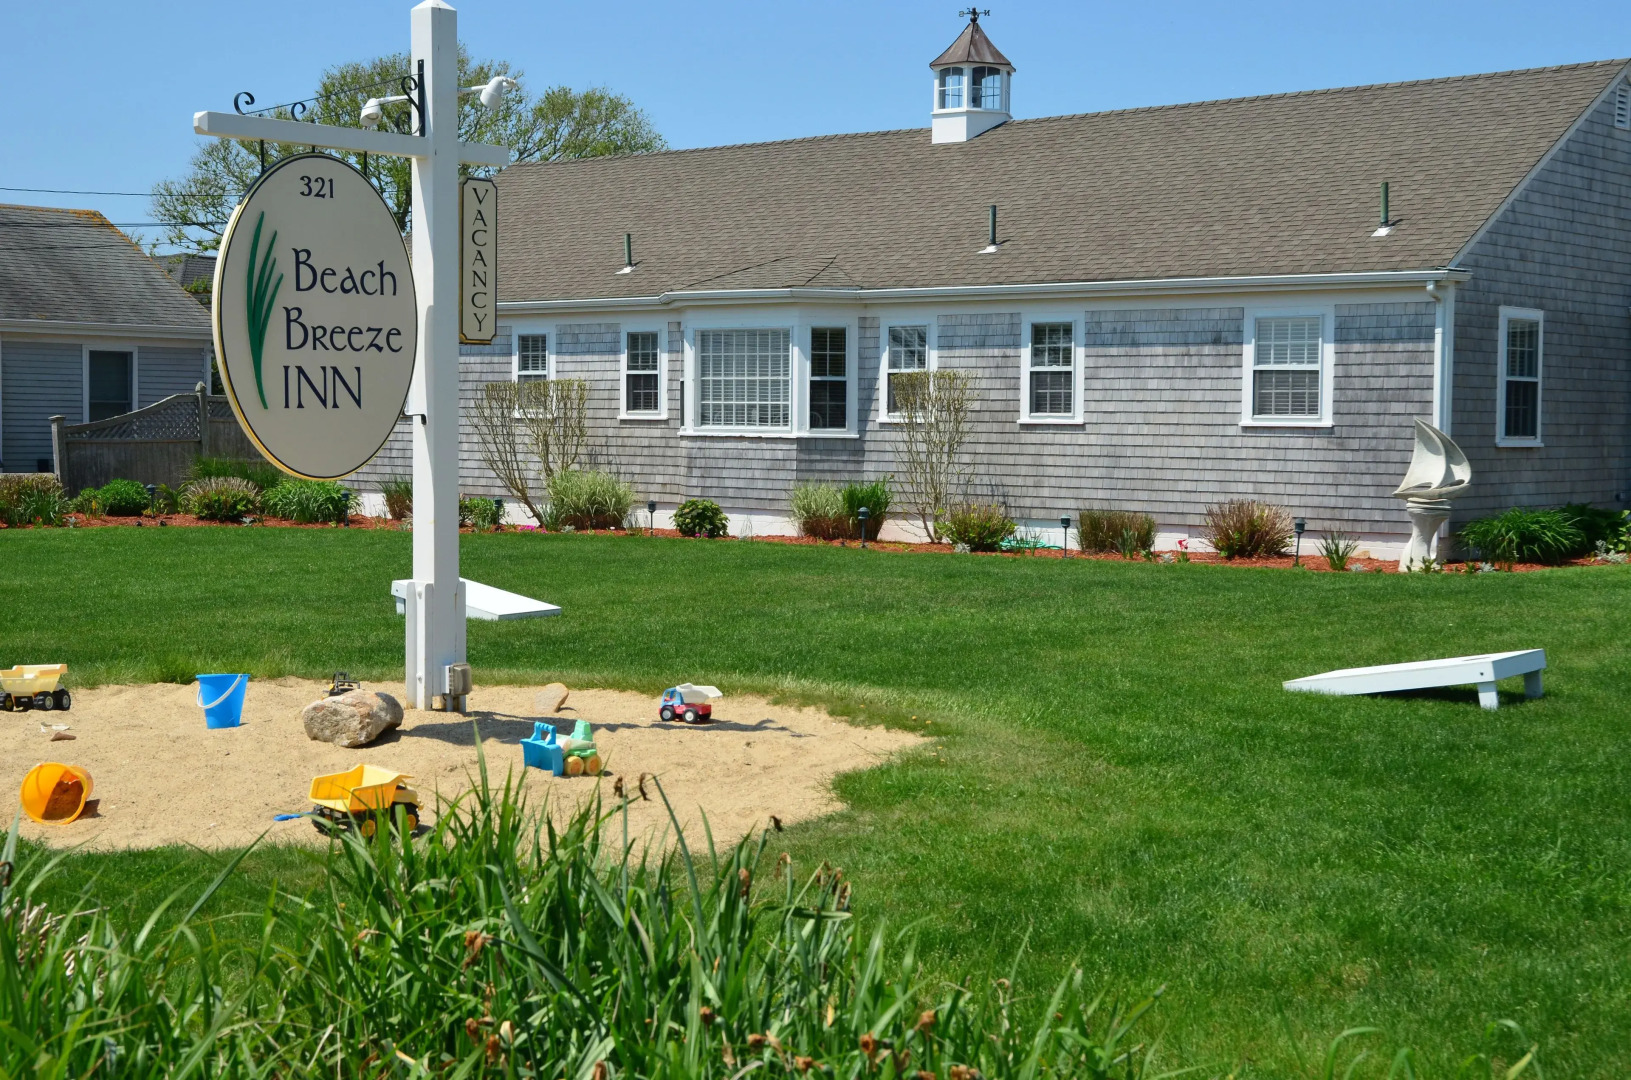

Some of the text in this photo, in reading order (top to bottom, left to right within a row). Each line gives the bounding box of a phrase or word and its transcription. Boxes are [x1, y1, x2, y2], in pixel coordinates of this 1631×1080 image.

[300, 176, 334, 198] 321
[291, 248, 397, 296] Beach
[471, 188, 490, 332] VACANCY
[283, 306, 402, 352] Breeze
[283, 365, 362, 409] INN
